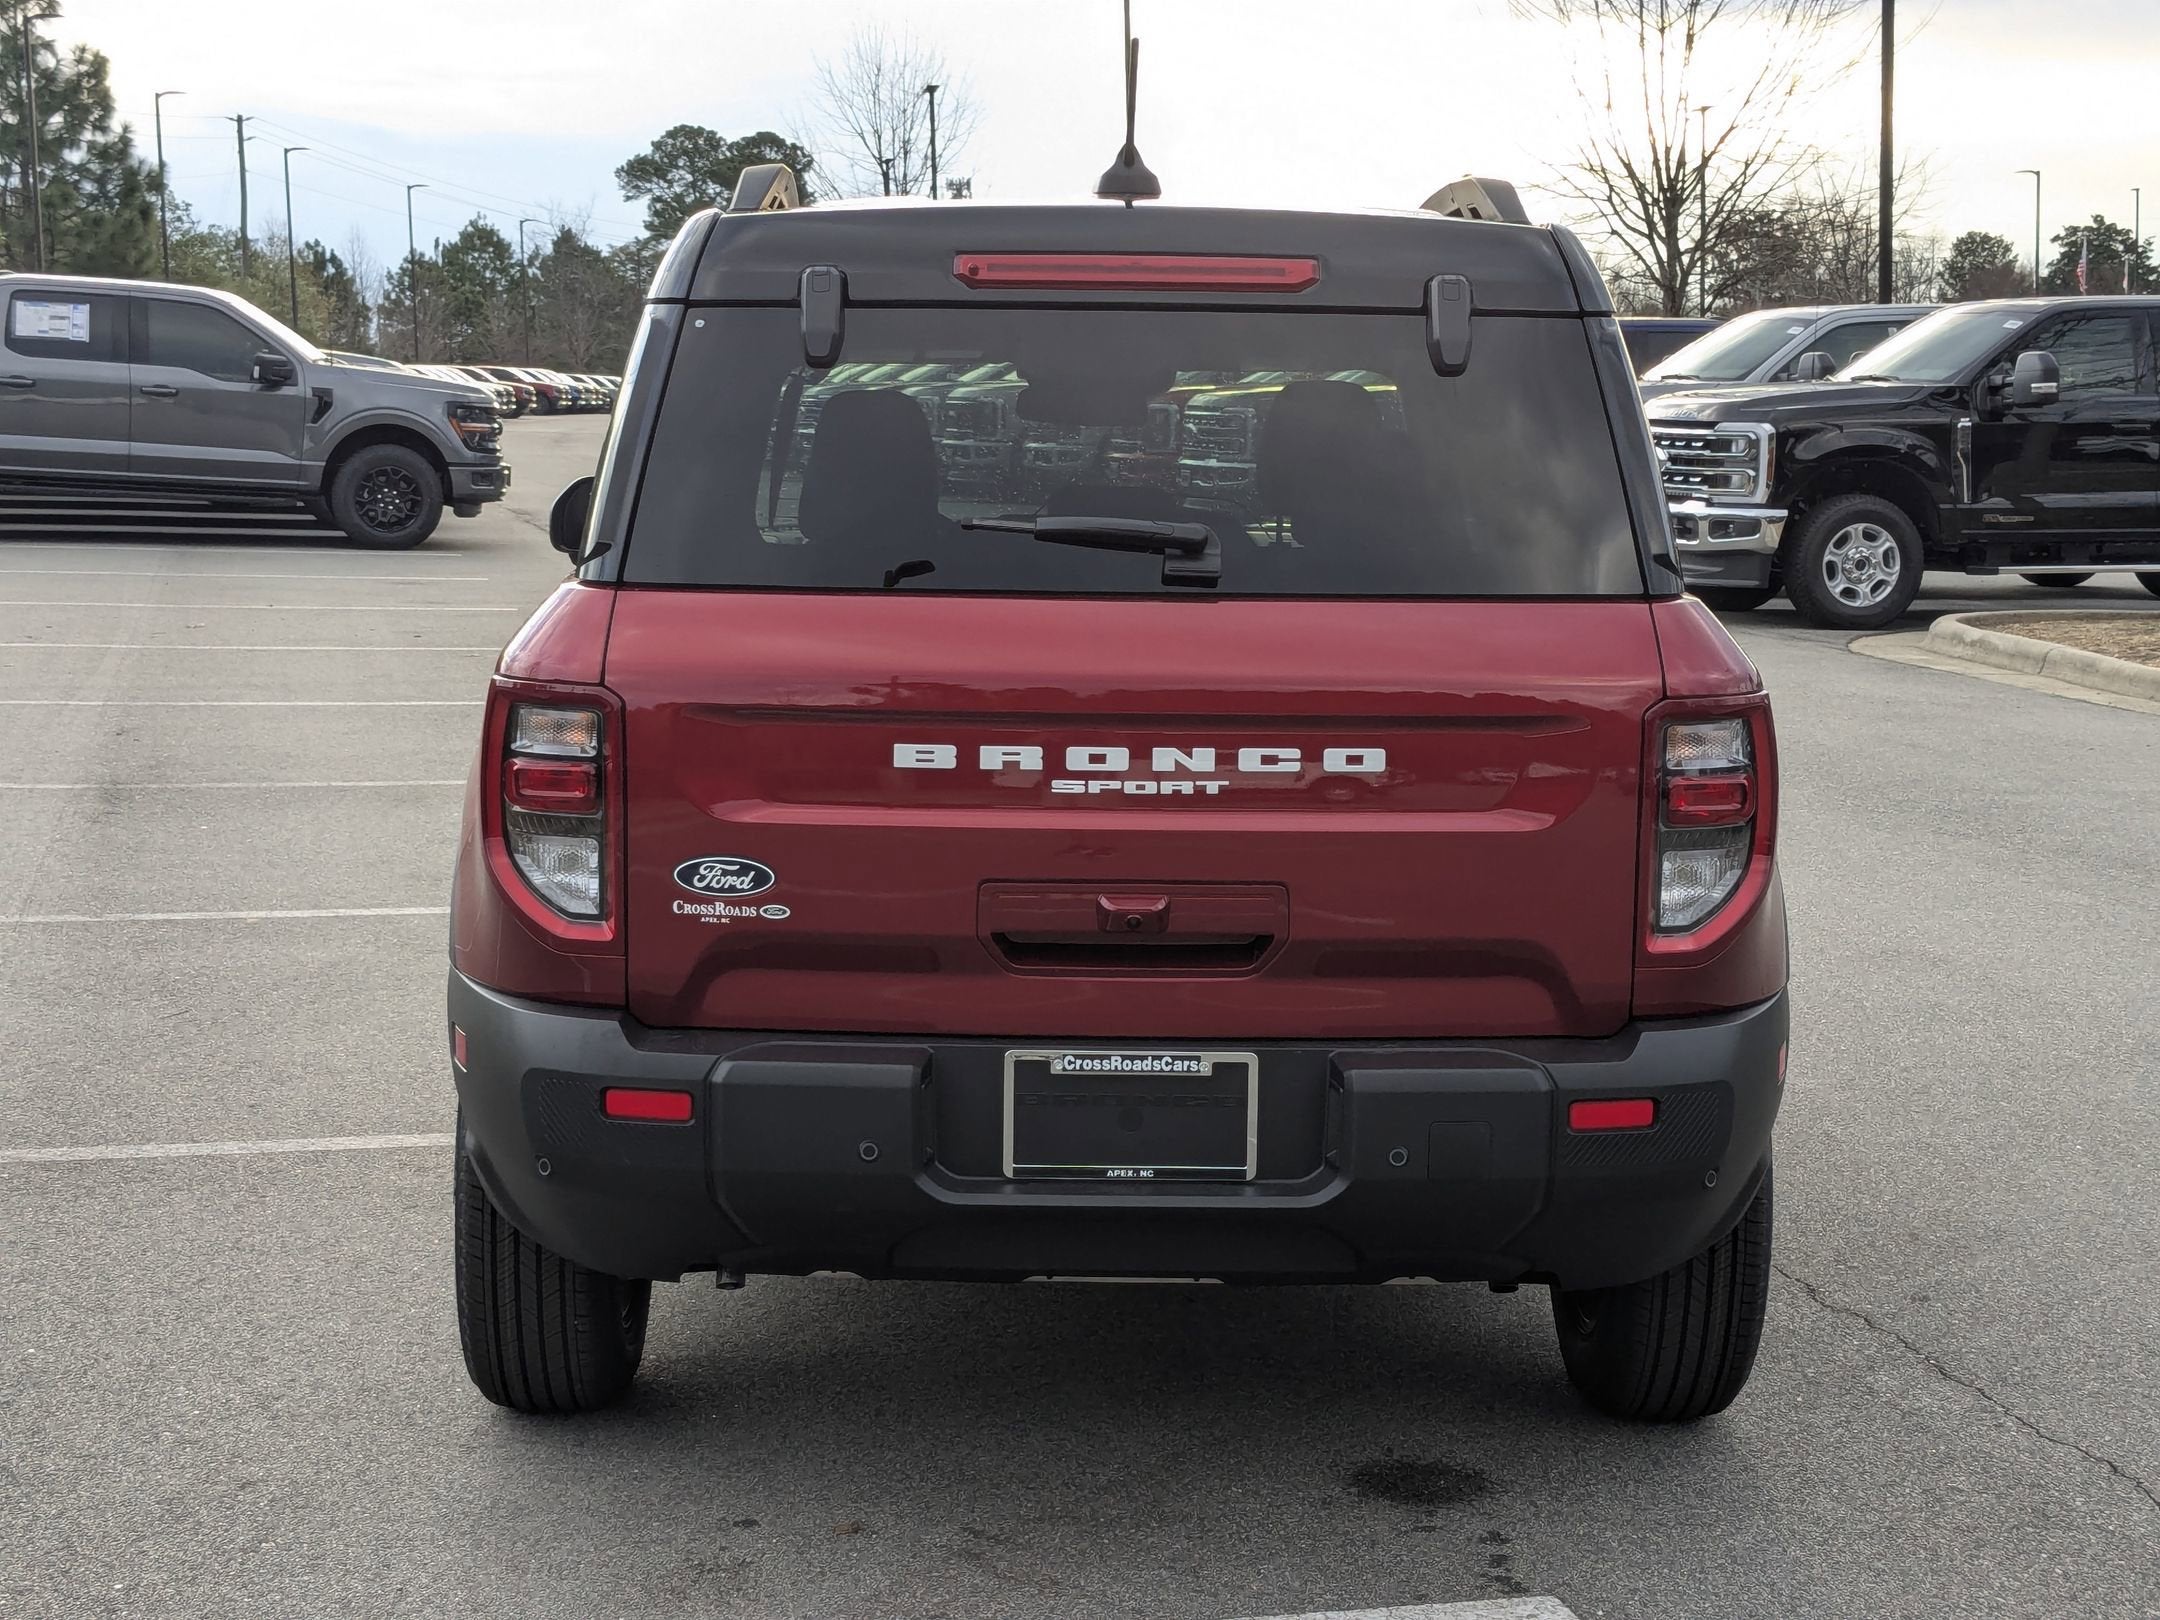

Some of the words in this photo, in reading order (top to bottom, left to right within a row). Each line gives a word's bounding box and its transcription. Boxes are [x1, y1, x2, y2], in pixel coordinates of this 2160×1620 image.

[893, 743, 1386, 772] BRONCO
[1051, 780, 1229, 794] SPORT
[693, 863, 754, 889] Ford
[1063, 1055, 1200, 1072] CrossRoadsCars
[1140, 1169, 1154, 1177] NC
